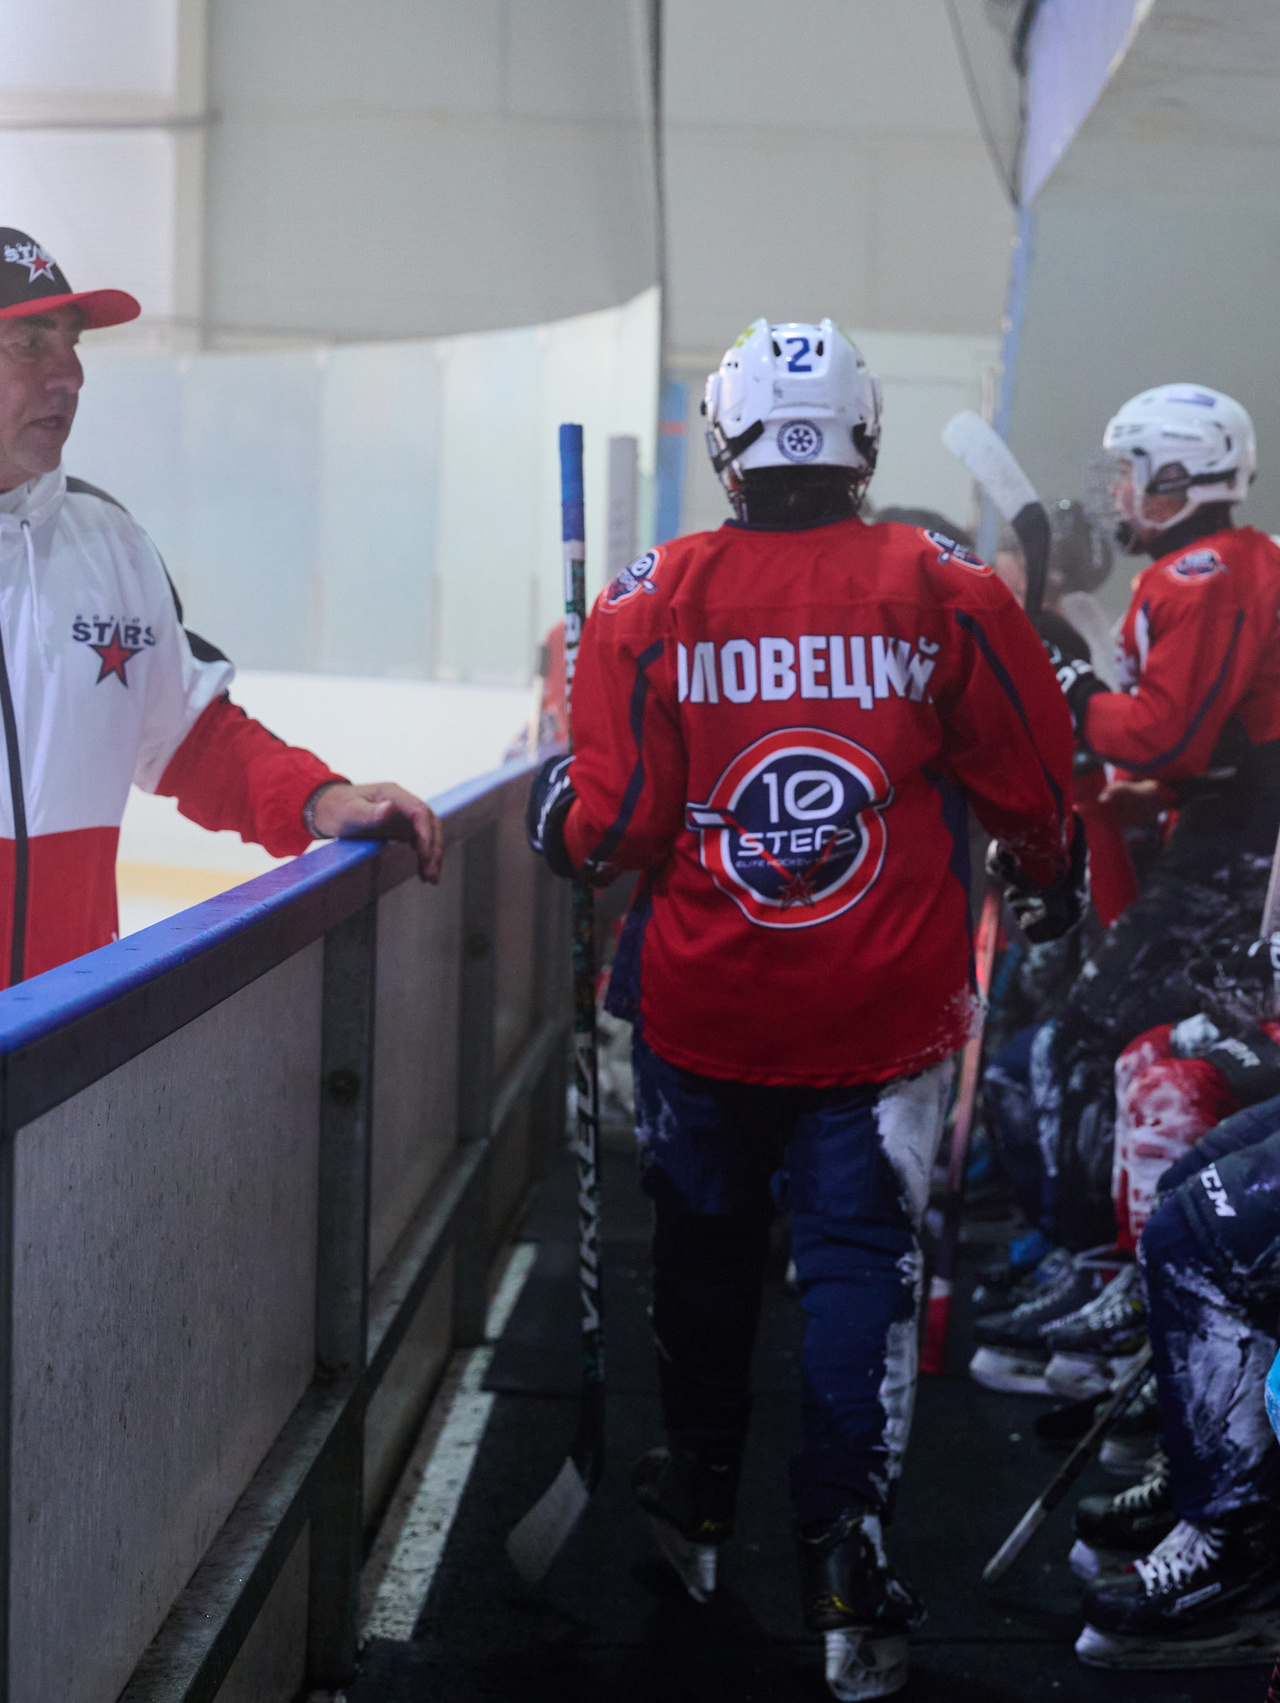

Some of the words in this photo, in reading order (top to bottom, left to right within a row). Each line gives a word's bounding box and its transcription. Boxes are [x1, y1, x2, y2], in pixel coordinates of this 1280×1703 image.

[786, 336, 812, 372] 2
[762, 769, 845, 824] 10
[1200, 1162, 1237, 1217] CM
